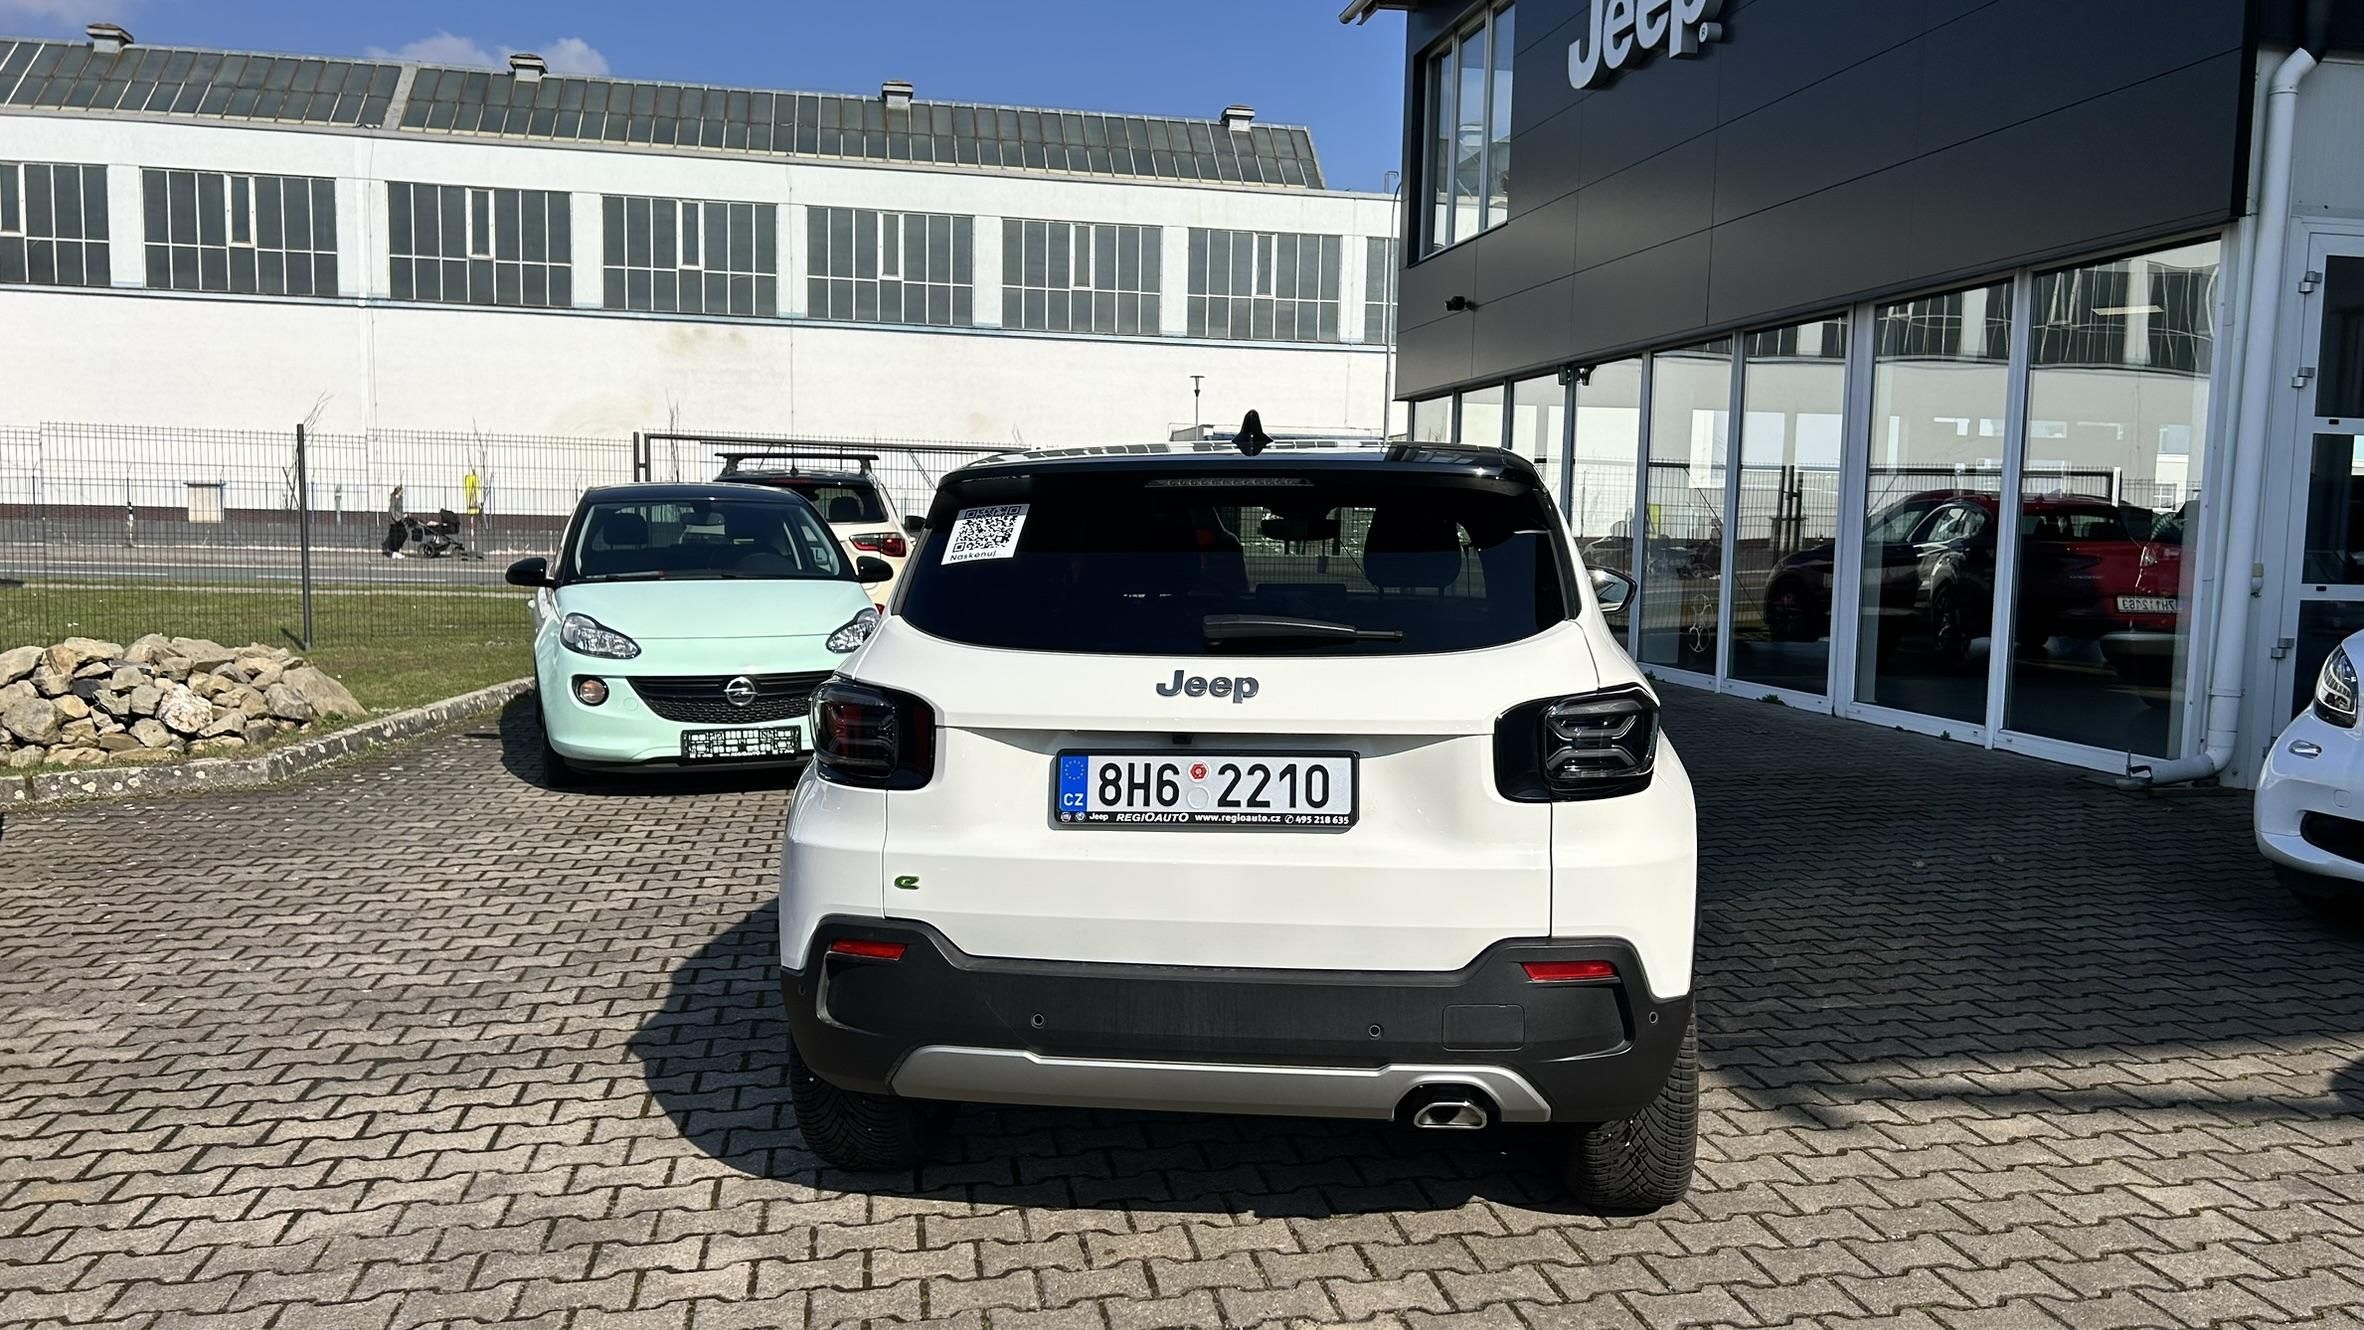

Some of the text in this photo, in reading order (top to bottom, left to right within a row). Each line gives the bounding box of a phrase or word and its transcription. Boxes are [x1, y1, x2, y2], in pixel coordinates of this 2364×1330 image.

[1156, 670, 1259, 704] Jeep
[1097, 763, 1330, 809] 8H6 2210
[1064, 793, 1084, 806] CZ
[1089, 812, 1349, 825] Jeep REGIOAUTO www.regioauto.cz 495 218 635
